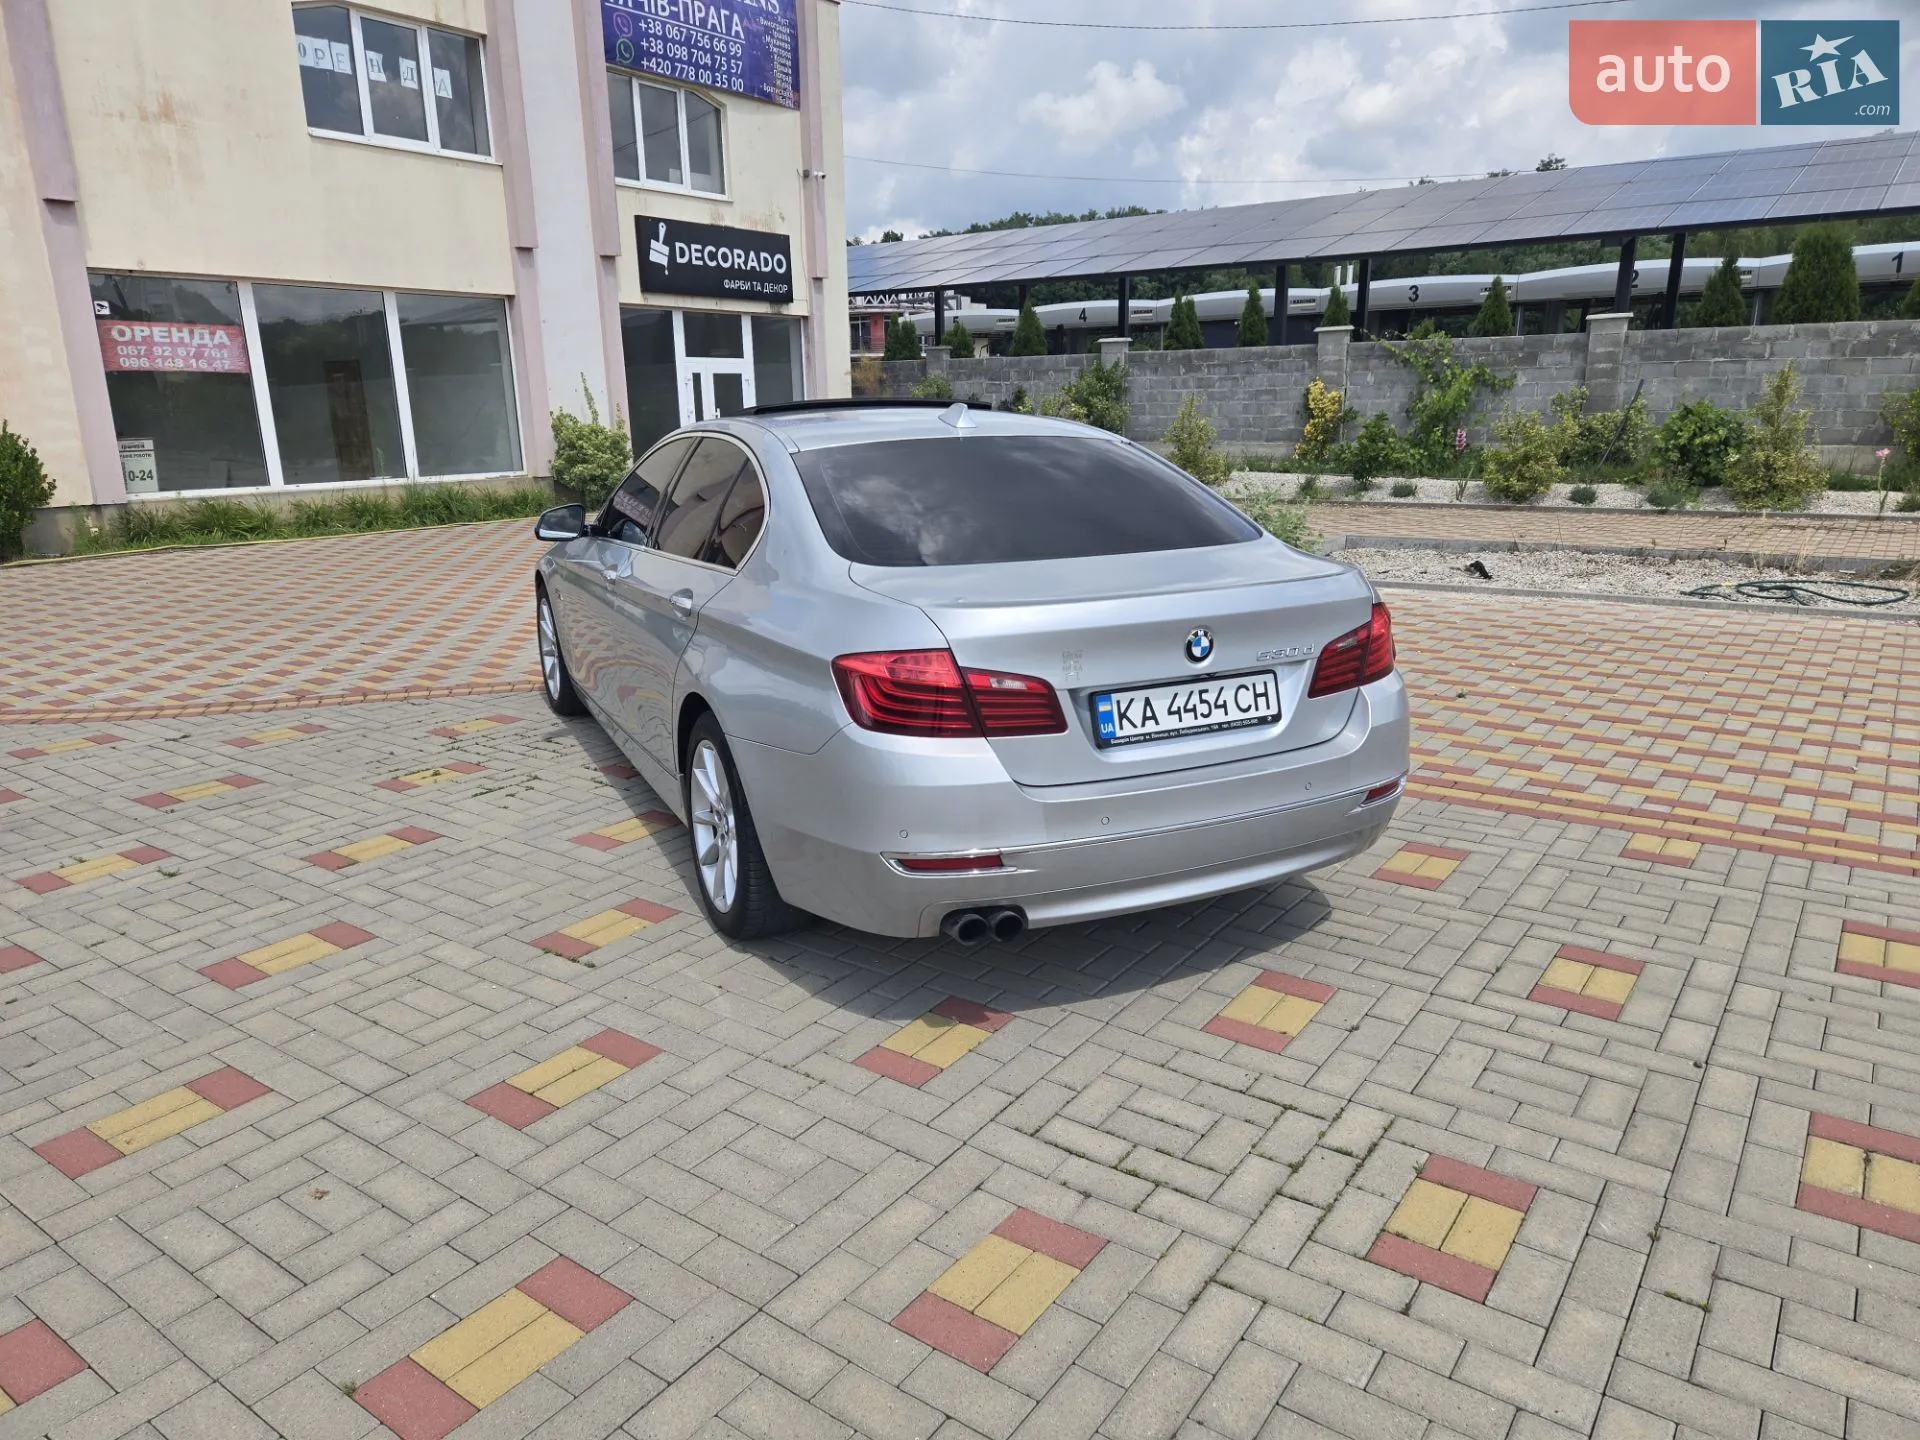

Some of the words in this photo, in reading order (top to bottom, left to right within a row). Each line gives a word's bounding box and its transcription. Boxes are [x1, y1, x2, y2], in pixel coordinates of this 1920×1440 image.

[611, 0, 745, 39] ЧІВ-ПРАГА
[638, 19, 662, 36] +38
[665, 24, 686, 41] 067
[690, 30, 711, 48] 756
[713, 38, 727, 53] 66
[729, 42, 742, 57] 99
[641, 37, 664, 54] +38
[667, 43, 688, 60] 098
[691, 49, 711, 67] 704
[714, 55, 727, 70] 75
[730, 60, 742, 74] 57
[641, 57, 671, 75] +420
[675, 63, 695, 80] 778
[698, 69, 712, 84] 00
[715, 73, 728, 88] 35
[731, 77, 743, 91] 00
[675, 241, 787, 274] DECORADO
[1892, 252, 1904, 273] 1
[724, 279, 751, 290] ФАРБИ
[752, 281, 762, 291] ТА
[763, 282, 788, 294] ДЕКОР
[1408, 285, 1419, 302] 3
[1079, 307, 1087, 322] 4
[111, 326, 231, 347] ОРЕНДА
[117, 346, 147, 356] 067
[153, 346, 172, 356] 92
[120, 357, 149, 368] 096
[189, 359, 208, 369] 16
[1116, 697, 1160, 731] KA
[1167, 686, 1229, 723] 4454
[1234, 681, 1271, 713] CH
[1101, 722, 1114, 734] UA
